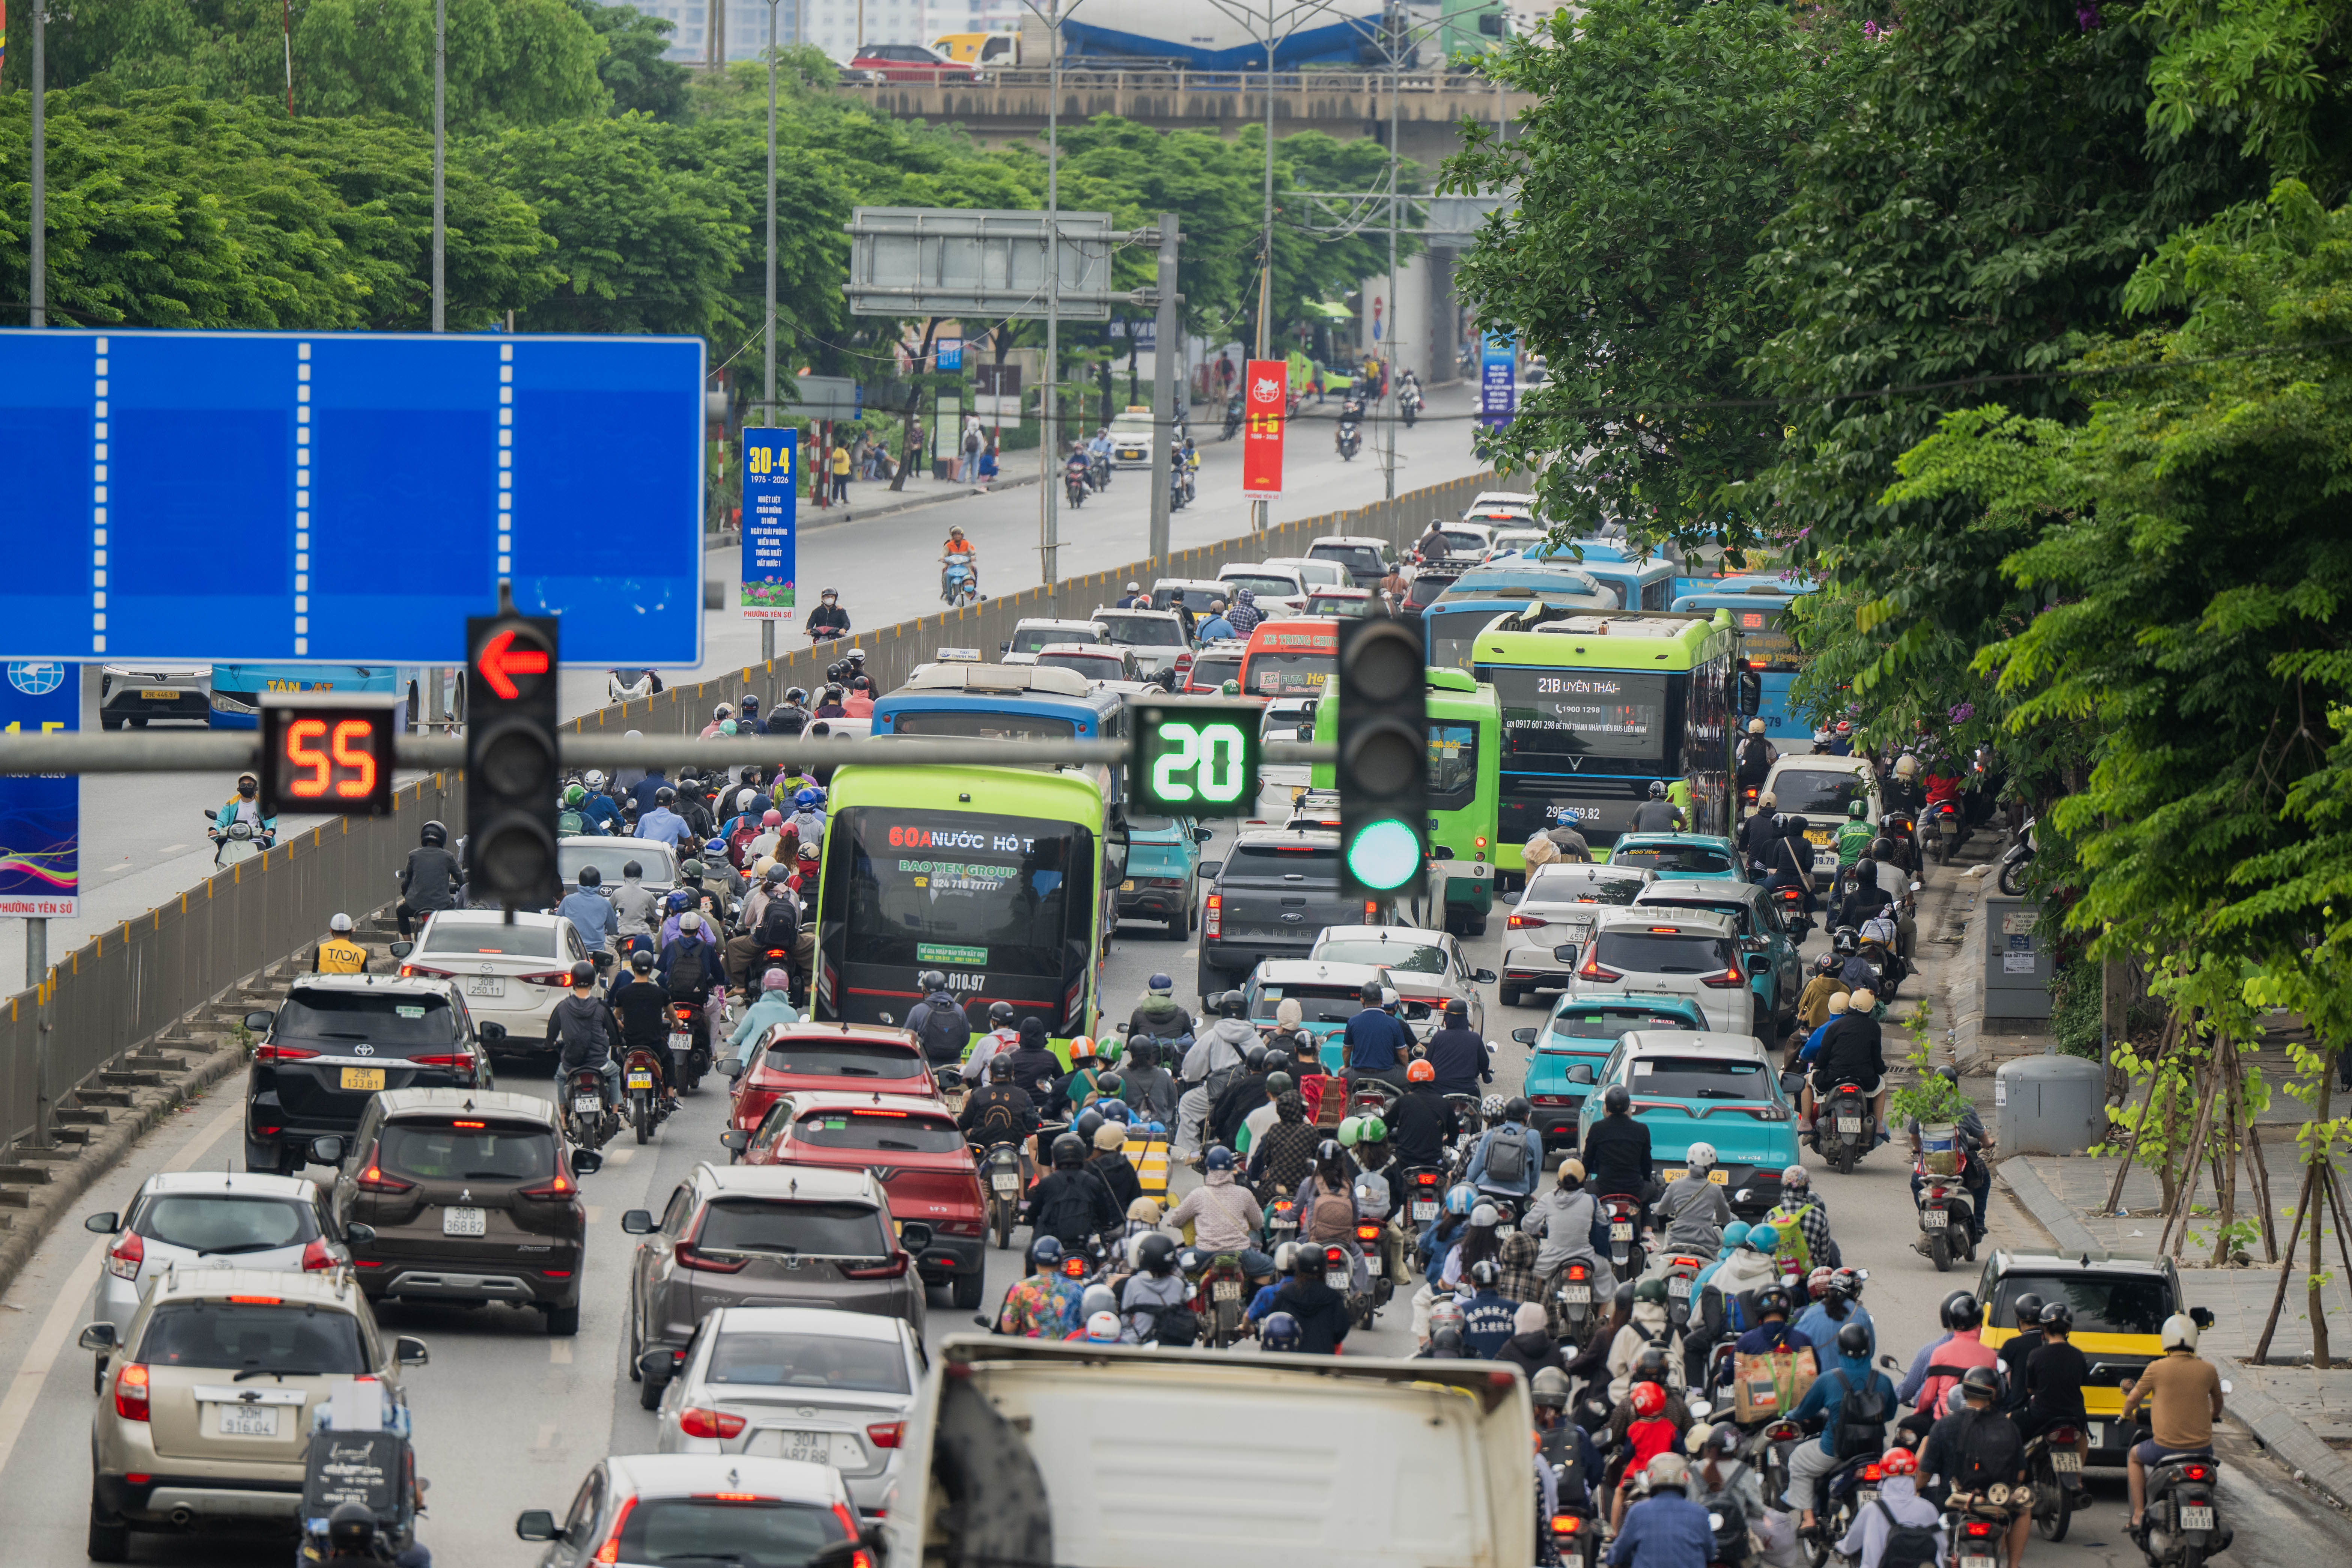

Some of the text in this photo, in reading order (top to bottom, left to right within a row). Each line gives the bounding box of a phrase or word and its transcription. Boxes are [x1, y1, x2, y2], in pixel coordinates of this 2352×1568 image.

[1251, 413, 1279, 433] 1-5
[750, 447, 789, 474] 30-4
[757, 496, 781, 504] NHIỆT LIỆT
[769, 505, 782, 514] MỪNG
[764, 527, 772, 535] GIẢI
[773, 527, 788, 536] PHÓNG
[757, 537, 768, 545] MIỀN
[770, 548, 782, 557] NHẤT
[766, 559, 777, 567] NƯỚC
[744, 609, 792, 619] PHƯỜNG YÊN SỞ
[1263, 634, 1277, 645] XE
[1278, 634, 1311, 646] TRUNG
[1281, 675, 1304, 685] FUTA
[1538, 678, 1560, 693] 21B
[1563, 679, 1590, 693] UYÊN
[1515, 720, 1531, 729] 0917
[1531, 720, 1542, 729] 601
[1543, 720, 1555, 729] 298
[1555, 720, 1562, 729] ĐỂ
[1562, 721, 1572, 730] TRỞ
[1572, 722, 1588, 731] THÀNH
[1588, 723, 1602, 731] NHÂN
[1602, 723, 1613, 732] VIÊN
[1623, 724, 1634, 733] LIÊN
[288, 720, 375, 796] 55
[1153, 723, 1244, 801] 20
[1844, 824, 1868, 834] Grab
[899, 860, 1018, 878] BAO YEN GROUP
[933, 877, 999, 891] 024 710 77777
[0, 900, 74, 914] HƯỜNG YÊN SỞ
[327, 948, 361, 964] TADA
[478, 978, 494, 986] 30B
[471, 986, 499, 995] 250.11
[354, 1068, 372, 1078] 29K
[348, 1078, 379, 1089] 133.81
[454, 1208, 476, 1219] 30G
[446, 1220, 483, 1232] 368.82
[795, 1432, 818, 1448] 30A
